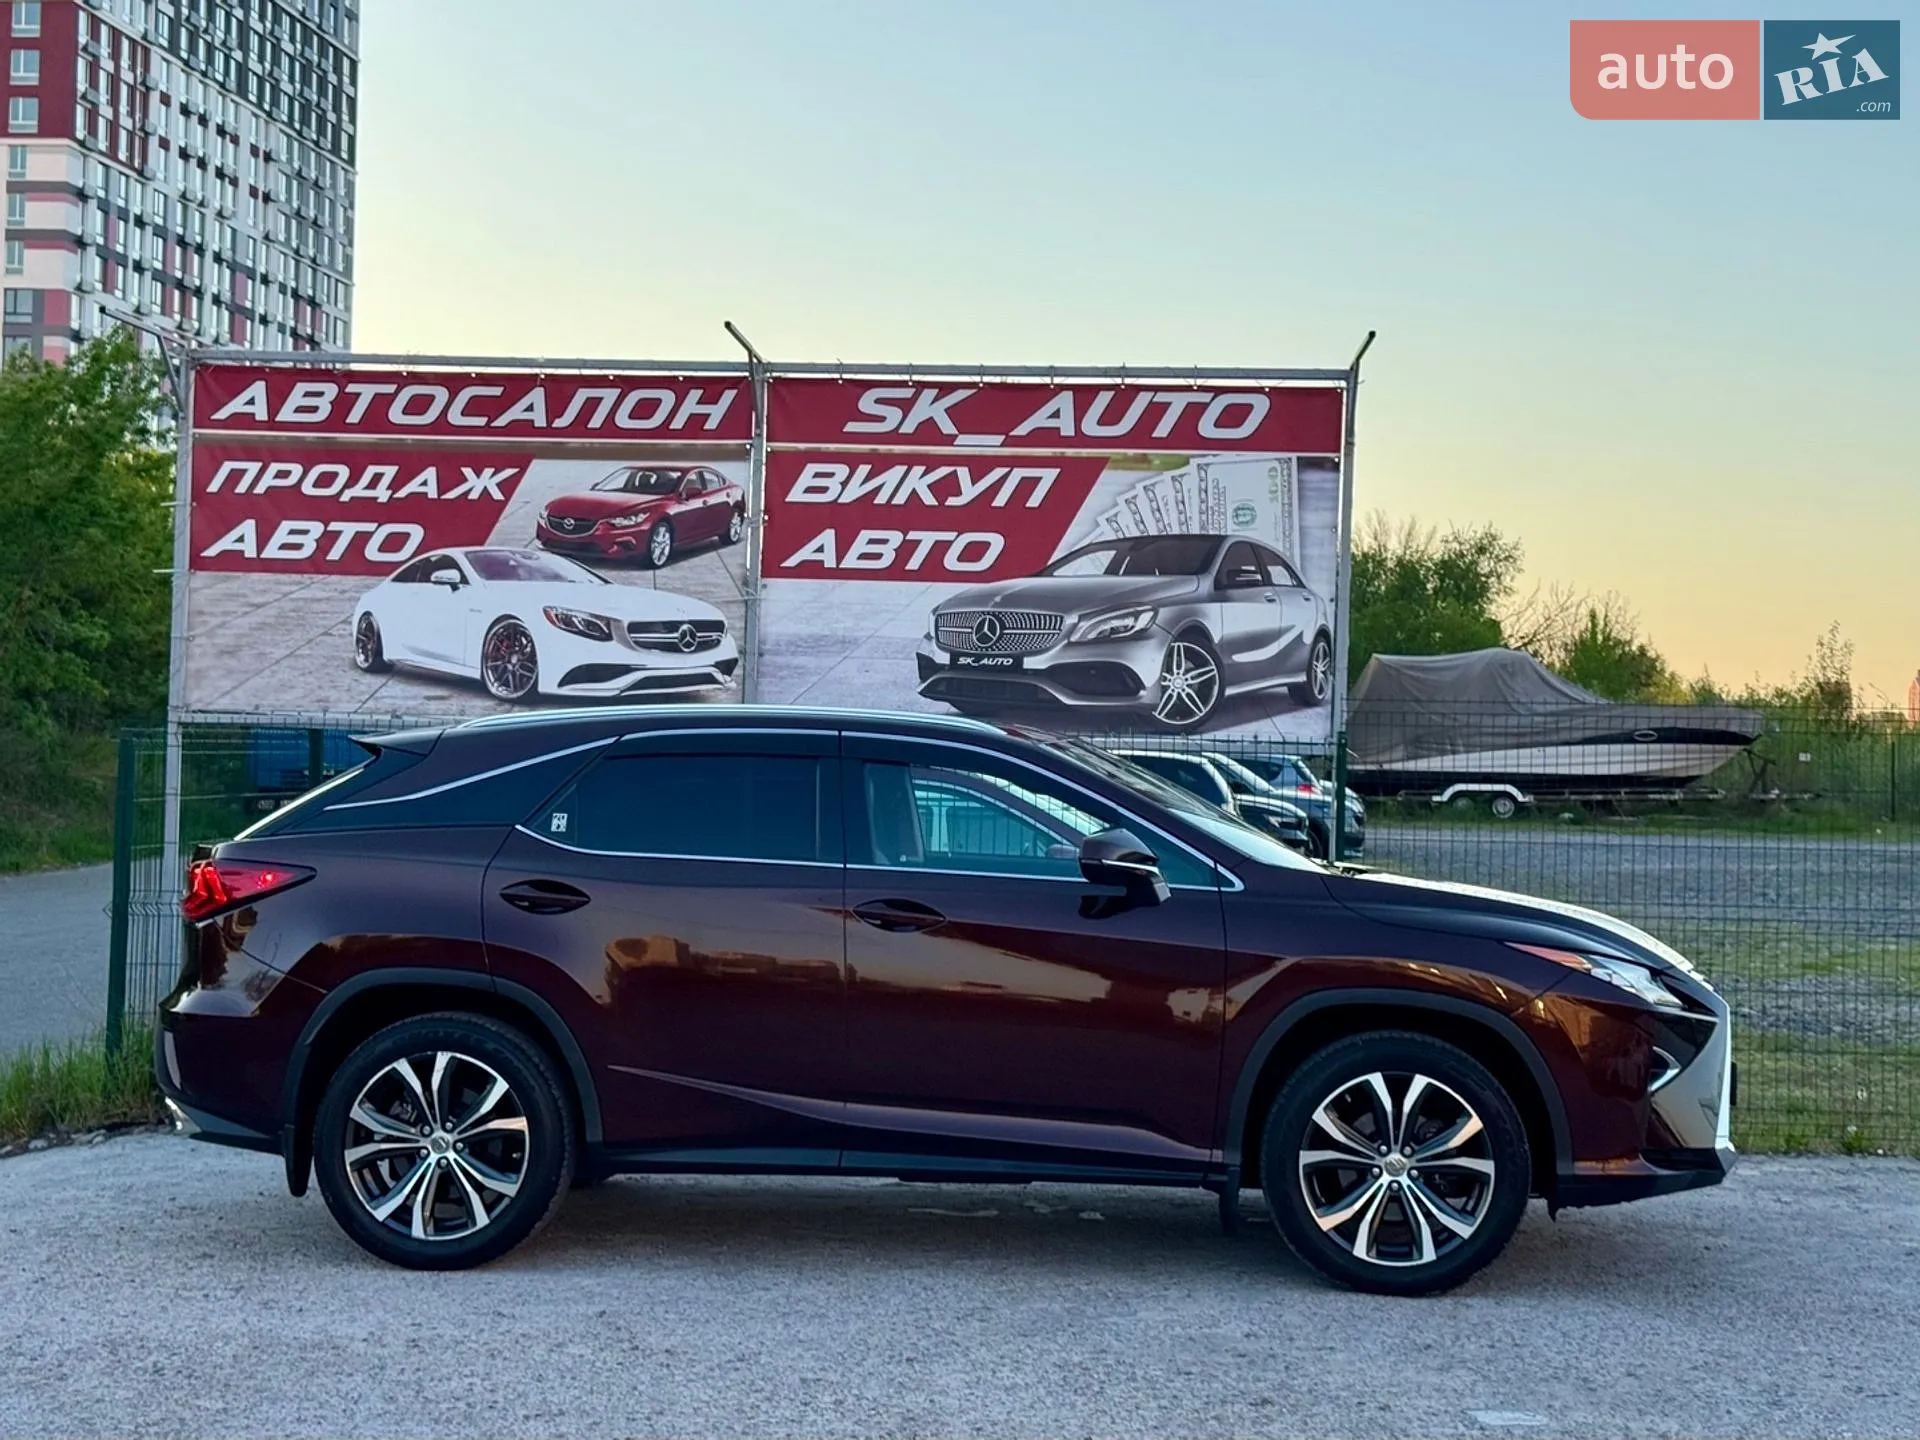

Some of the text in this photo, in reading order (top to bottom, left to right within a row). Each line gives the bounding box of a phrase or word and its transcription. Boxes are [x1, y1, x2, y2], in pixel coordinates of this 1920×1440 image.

[210, 379, 739, 430] АВТОСАЛОН
[842, 387, 1271, 447] SK_AUTO
[205, 460, 522, 503] ПРОДАЖ
[784, 462, 1062, 508] ВИКУП
[199, 518, 425, 563] АВТО
[779, 528, 1006, 572] АВТО
[957, 656, 1014, 667] SK_AUTO
